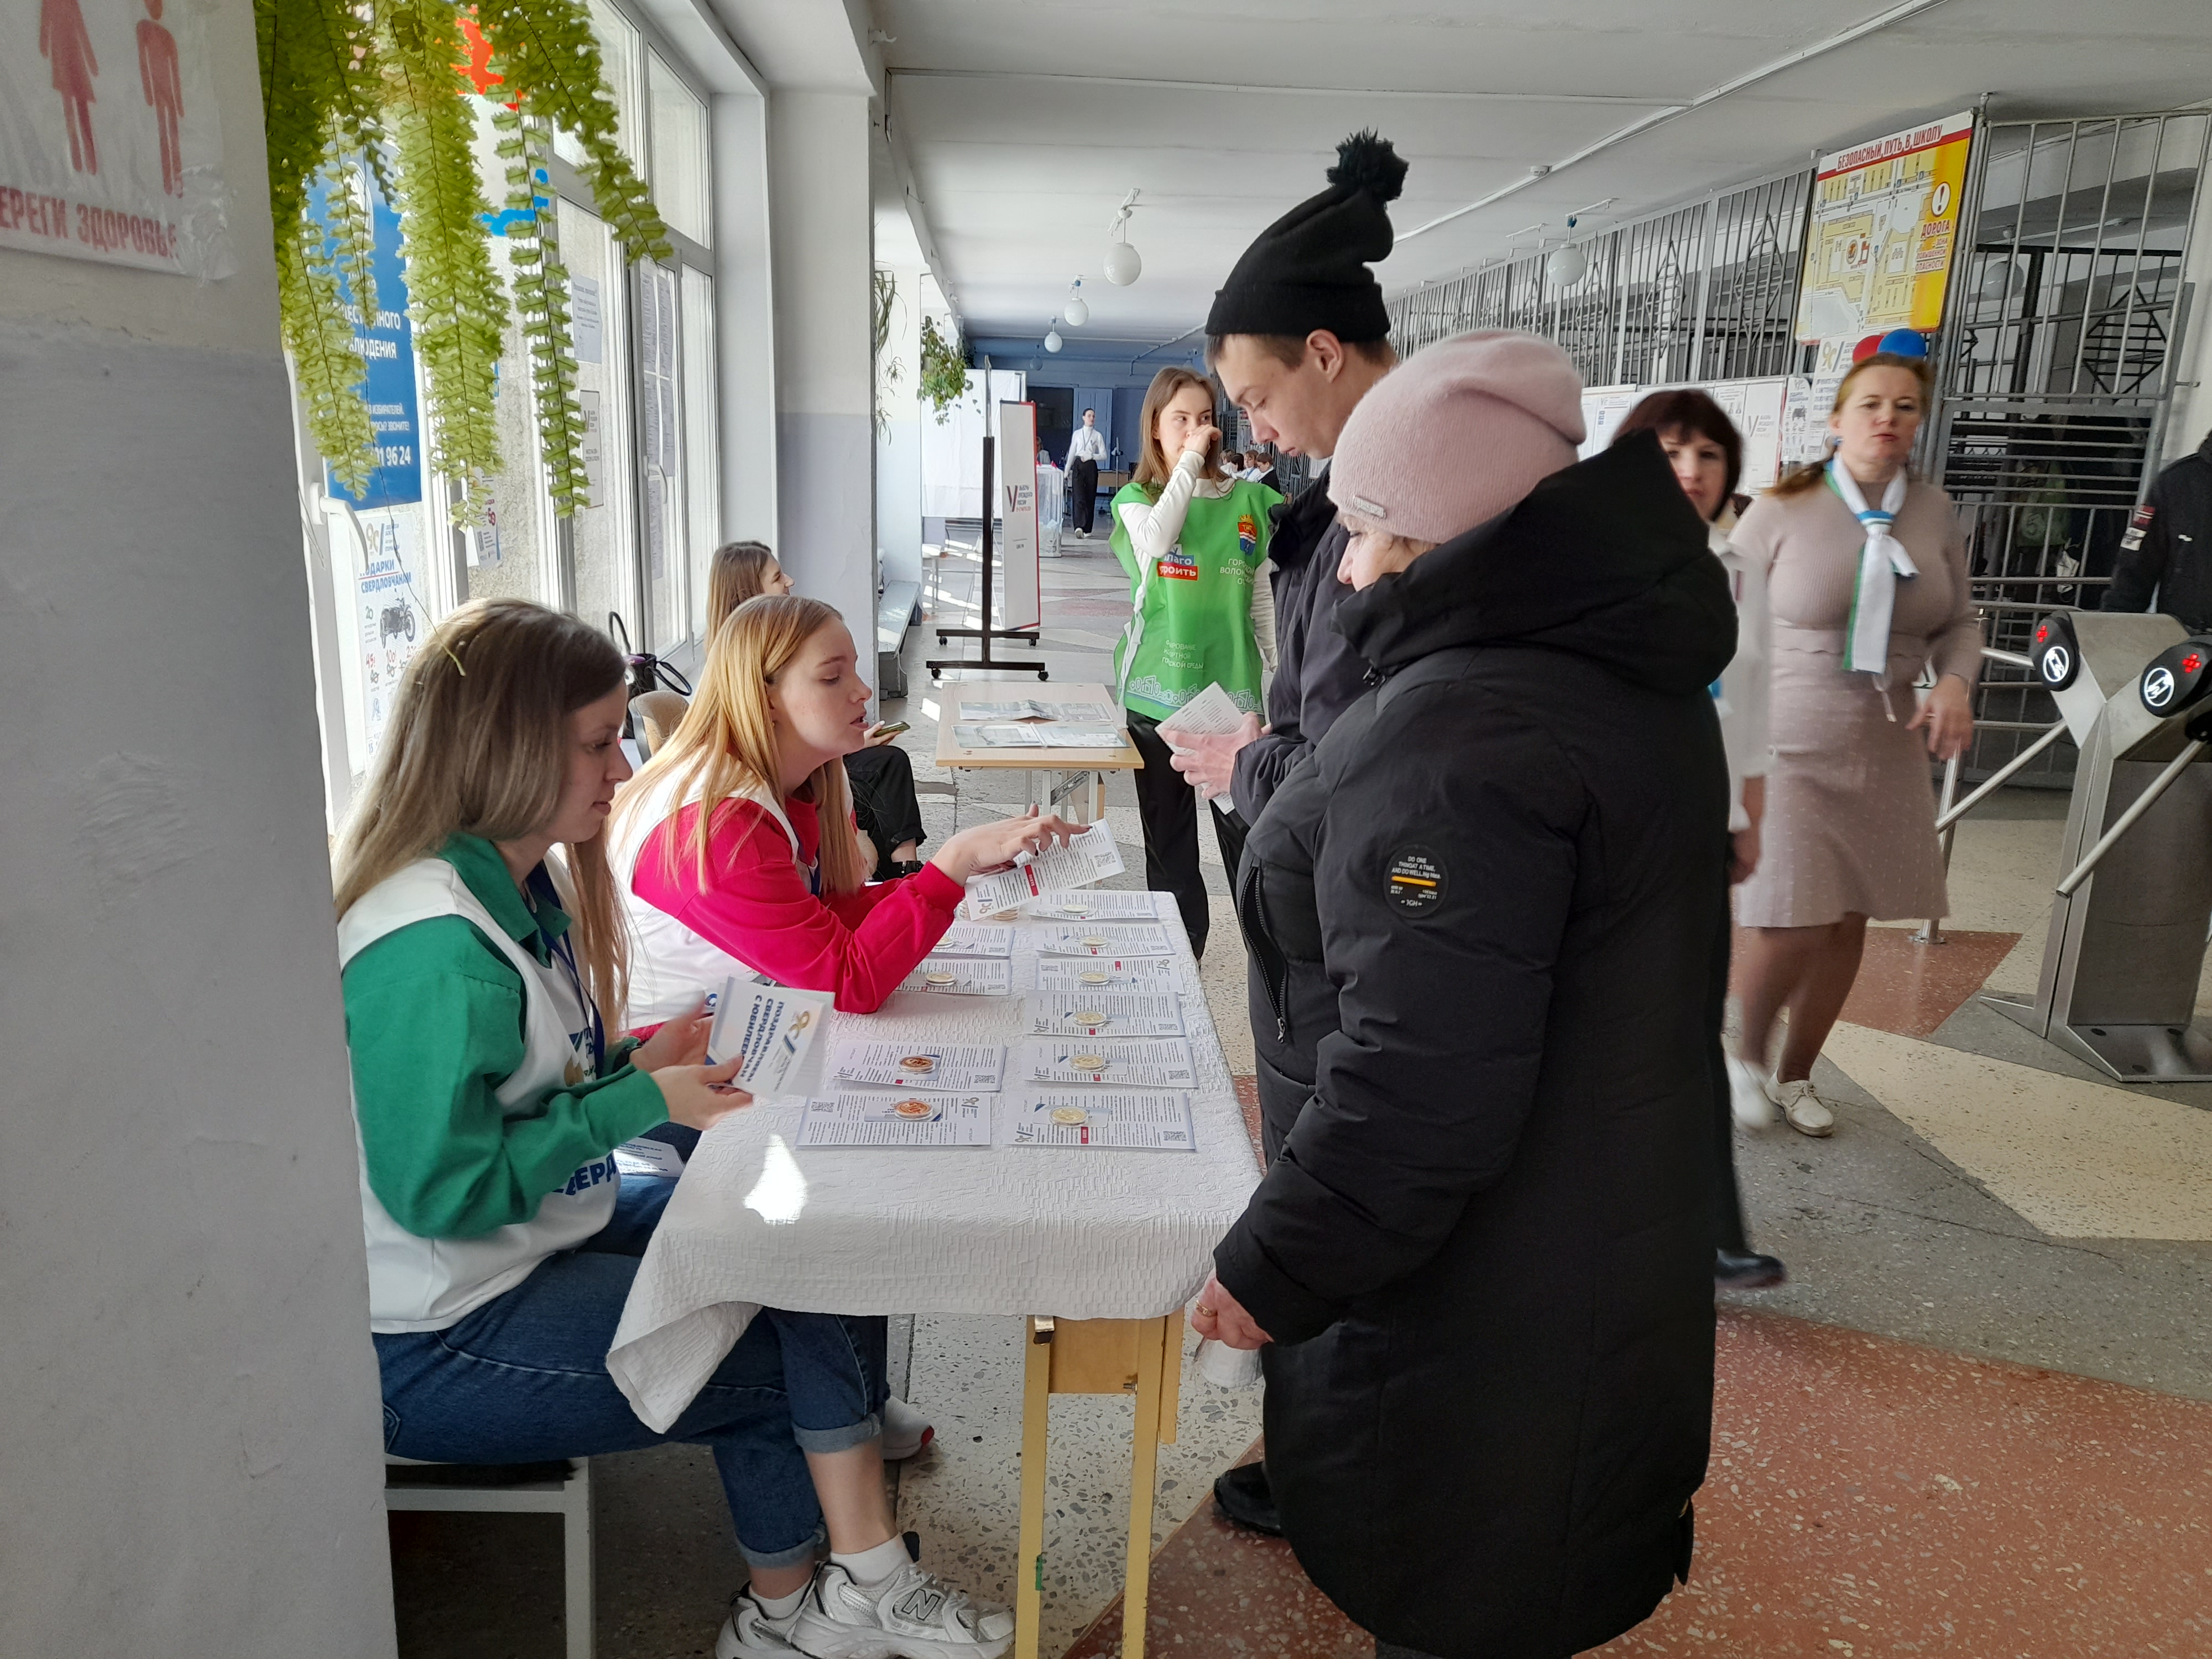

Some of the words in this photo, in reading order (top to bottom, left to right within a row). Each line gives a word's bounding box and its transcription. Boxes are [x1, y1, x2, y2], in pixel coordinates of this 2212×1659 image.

[1838, 140, 1883, 170] БЕЗОПАСНЫЙ
[1884, 136, 1902, 154] ПУТЬ
[1905, 134, 1911, 148] В
[1913, 124, 1943, 147] ШКОЛУ
[1921, 219, 1950, 238] ДОРОГА
[1915, 259, 1944, 271] ОПАСНОСТИ
[399, 446, 411, 466] 24
[361, 571, 412, 594] СВЕРДЛОВЧАНАМ
[739, 998, 774, 1078] СВЕРДЛОВЧАН
[902, 1588, 941, 1621] N
